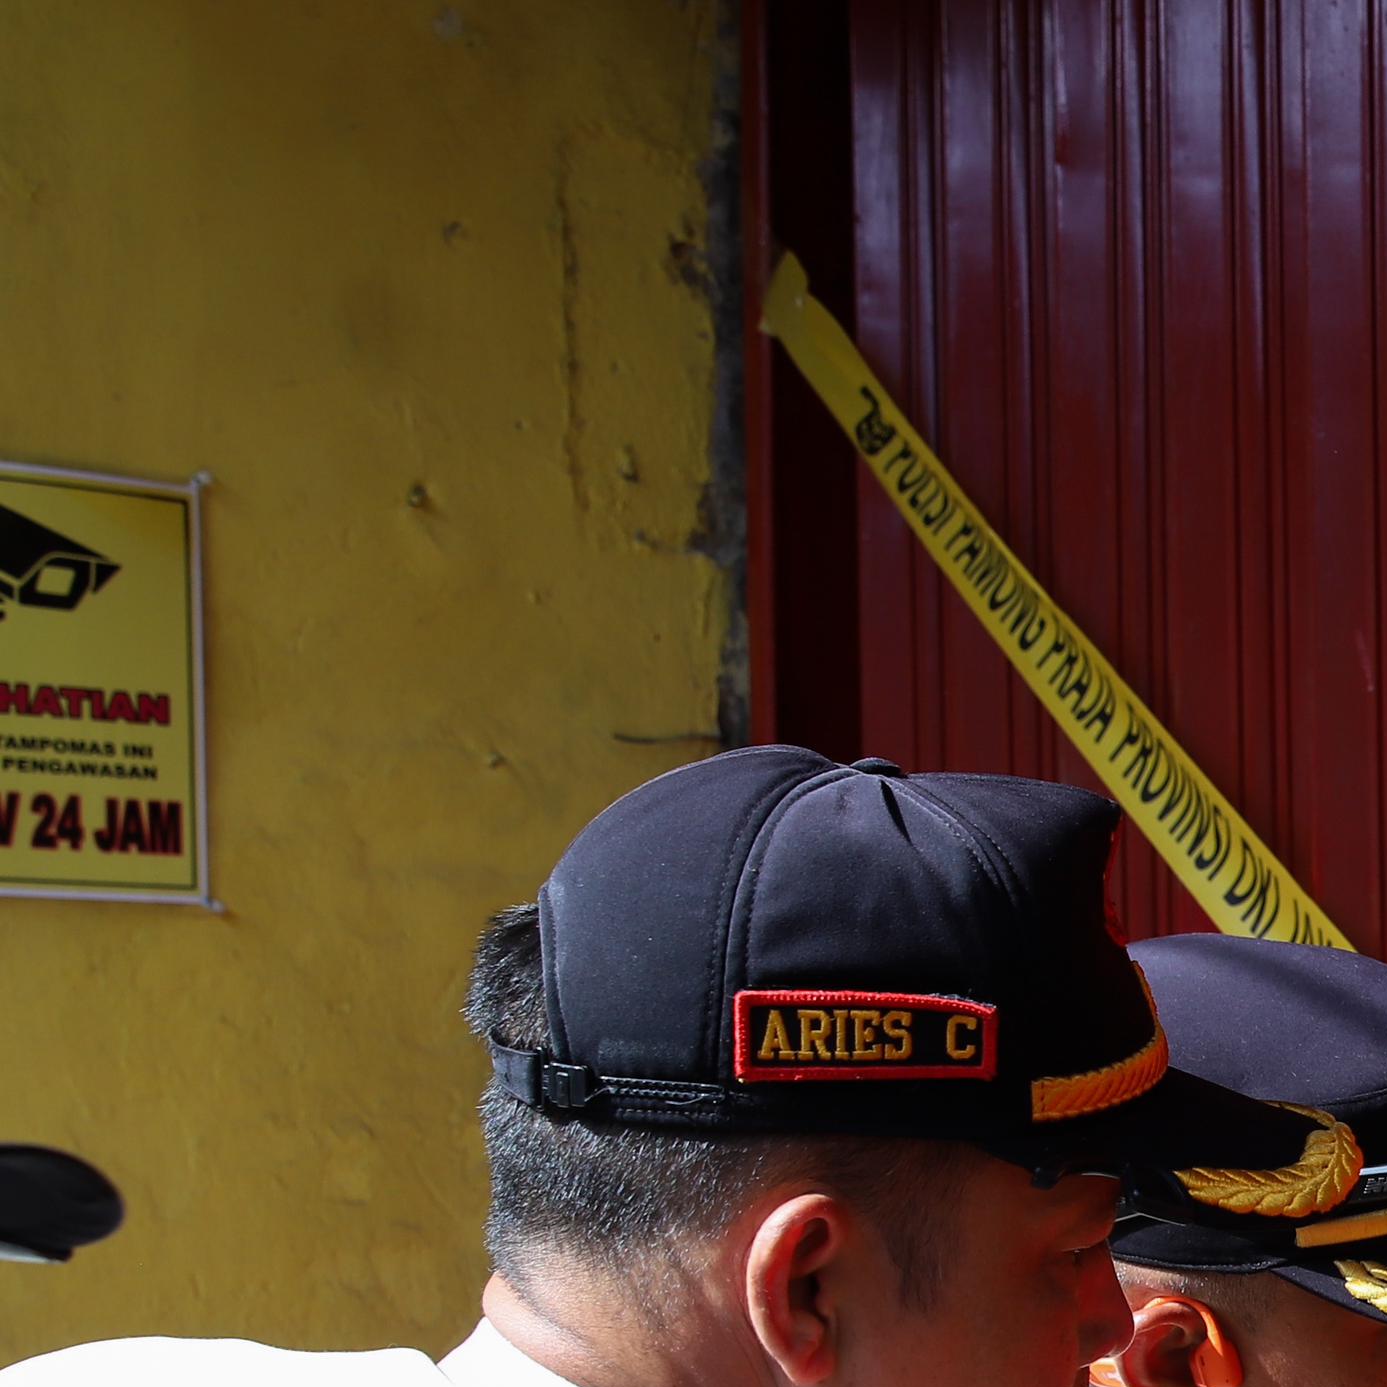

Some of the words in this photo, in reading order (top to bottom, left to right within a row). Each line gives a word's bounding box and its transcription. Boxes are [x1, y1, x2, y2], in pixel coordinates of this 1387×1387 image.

[3, 757, 159, 781] PENGAWASAN
[123, 743, 154, 759] INI
[30, 791, 85, 851] 24
[94, 797, 183, 855] JAM
[1109, 700, 1231, 881] PROVINSI
[1223, 834, 1280, 938] DKI
[757, 1009, 913, 1061] ARIES
[946, 1014, 977, 1060] C
